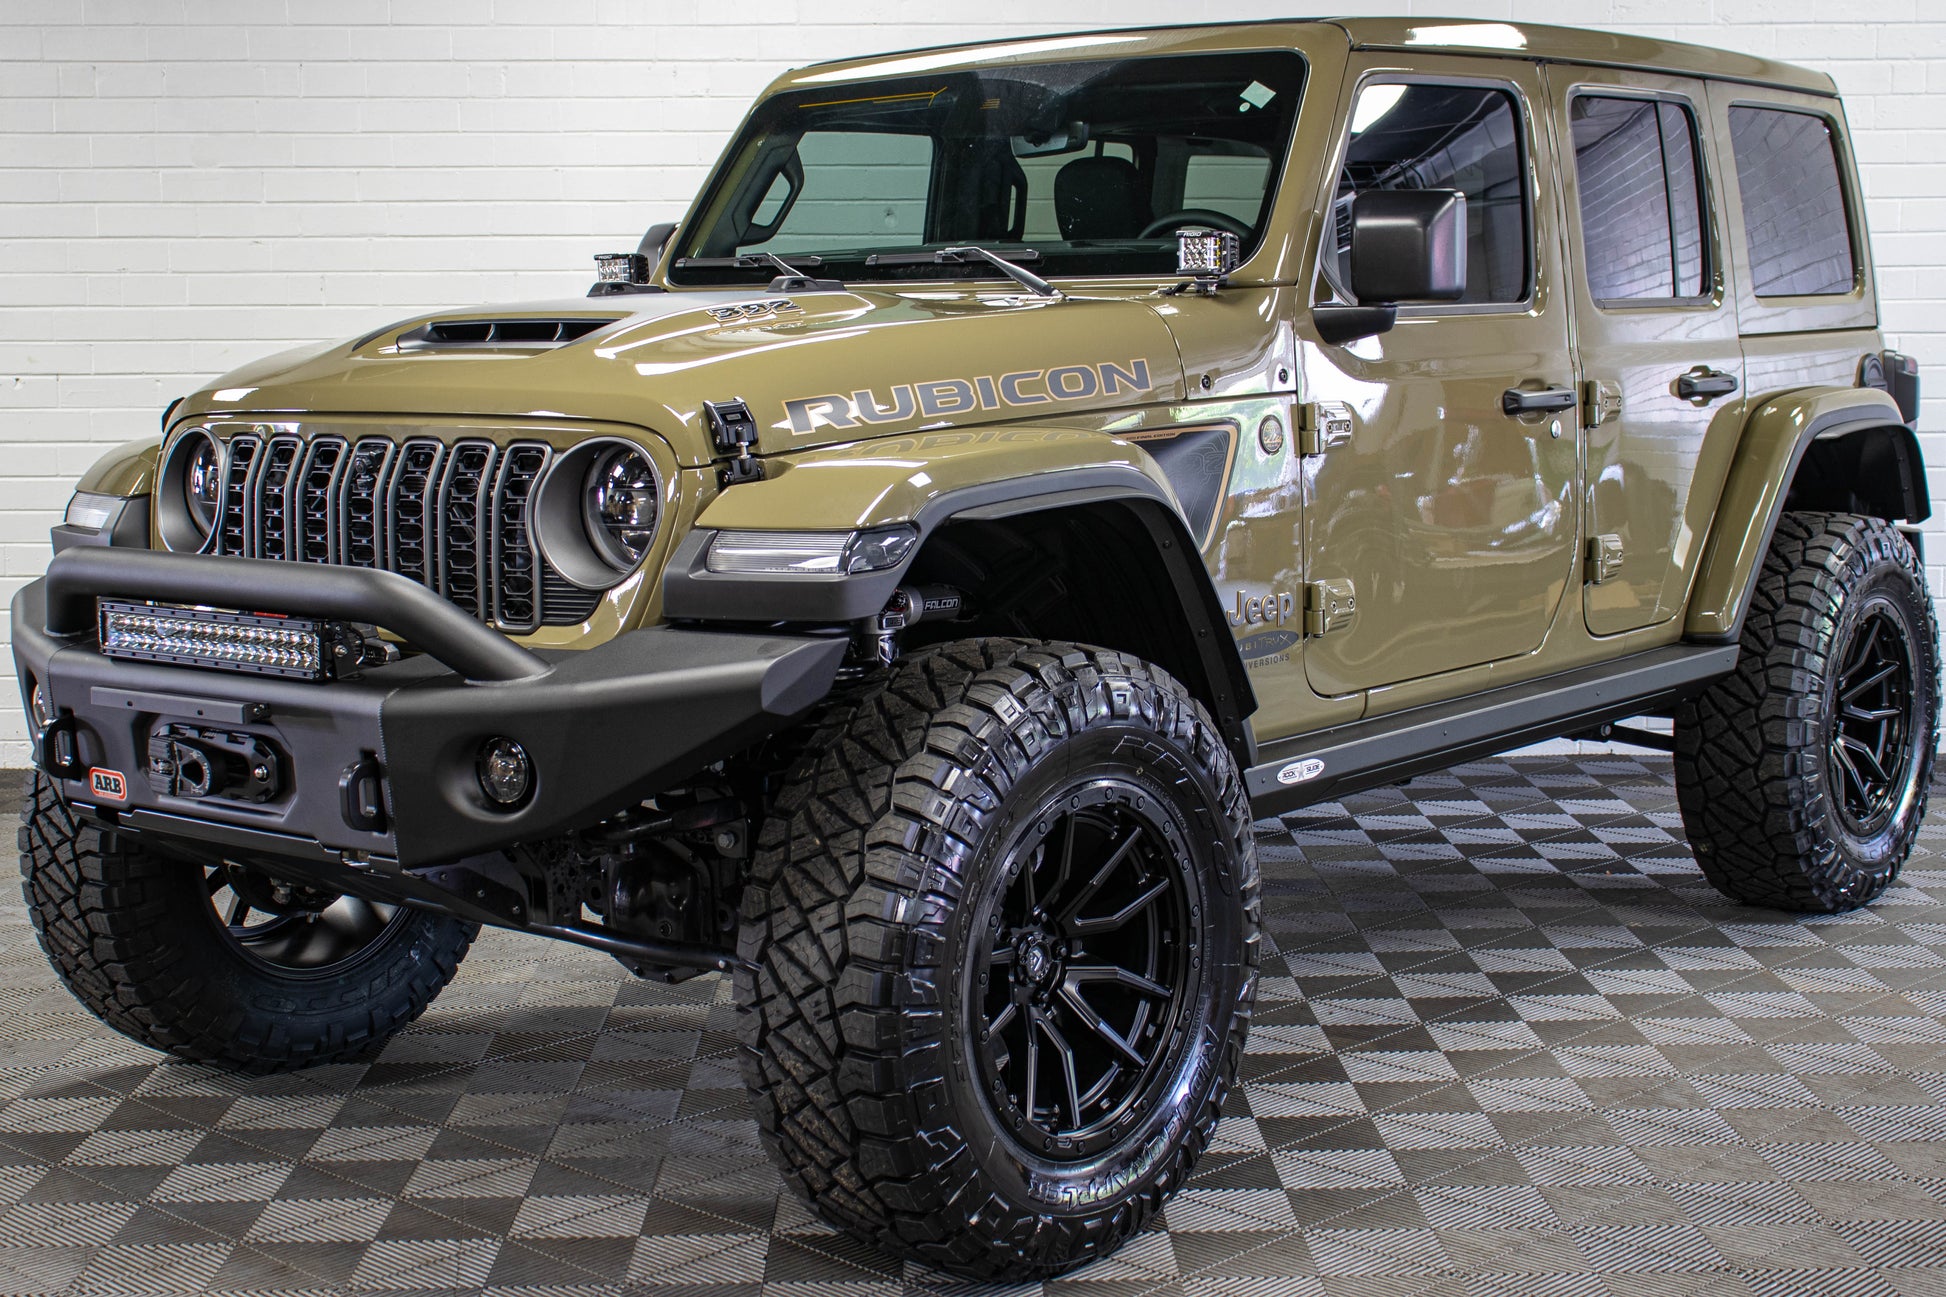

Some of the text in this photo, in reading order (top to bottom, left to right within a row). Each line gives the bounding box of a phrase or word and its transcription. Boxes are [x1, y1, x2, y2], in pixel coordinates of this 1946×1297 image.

[706, 299, 804, 322] 392
[781, 358, 1153, 436] RUBICON
[924, 598, 959, 610] FALCON
[1226, 589, 1294, 628] Jeep
[94, 774, 122, 794] ARB
